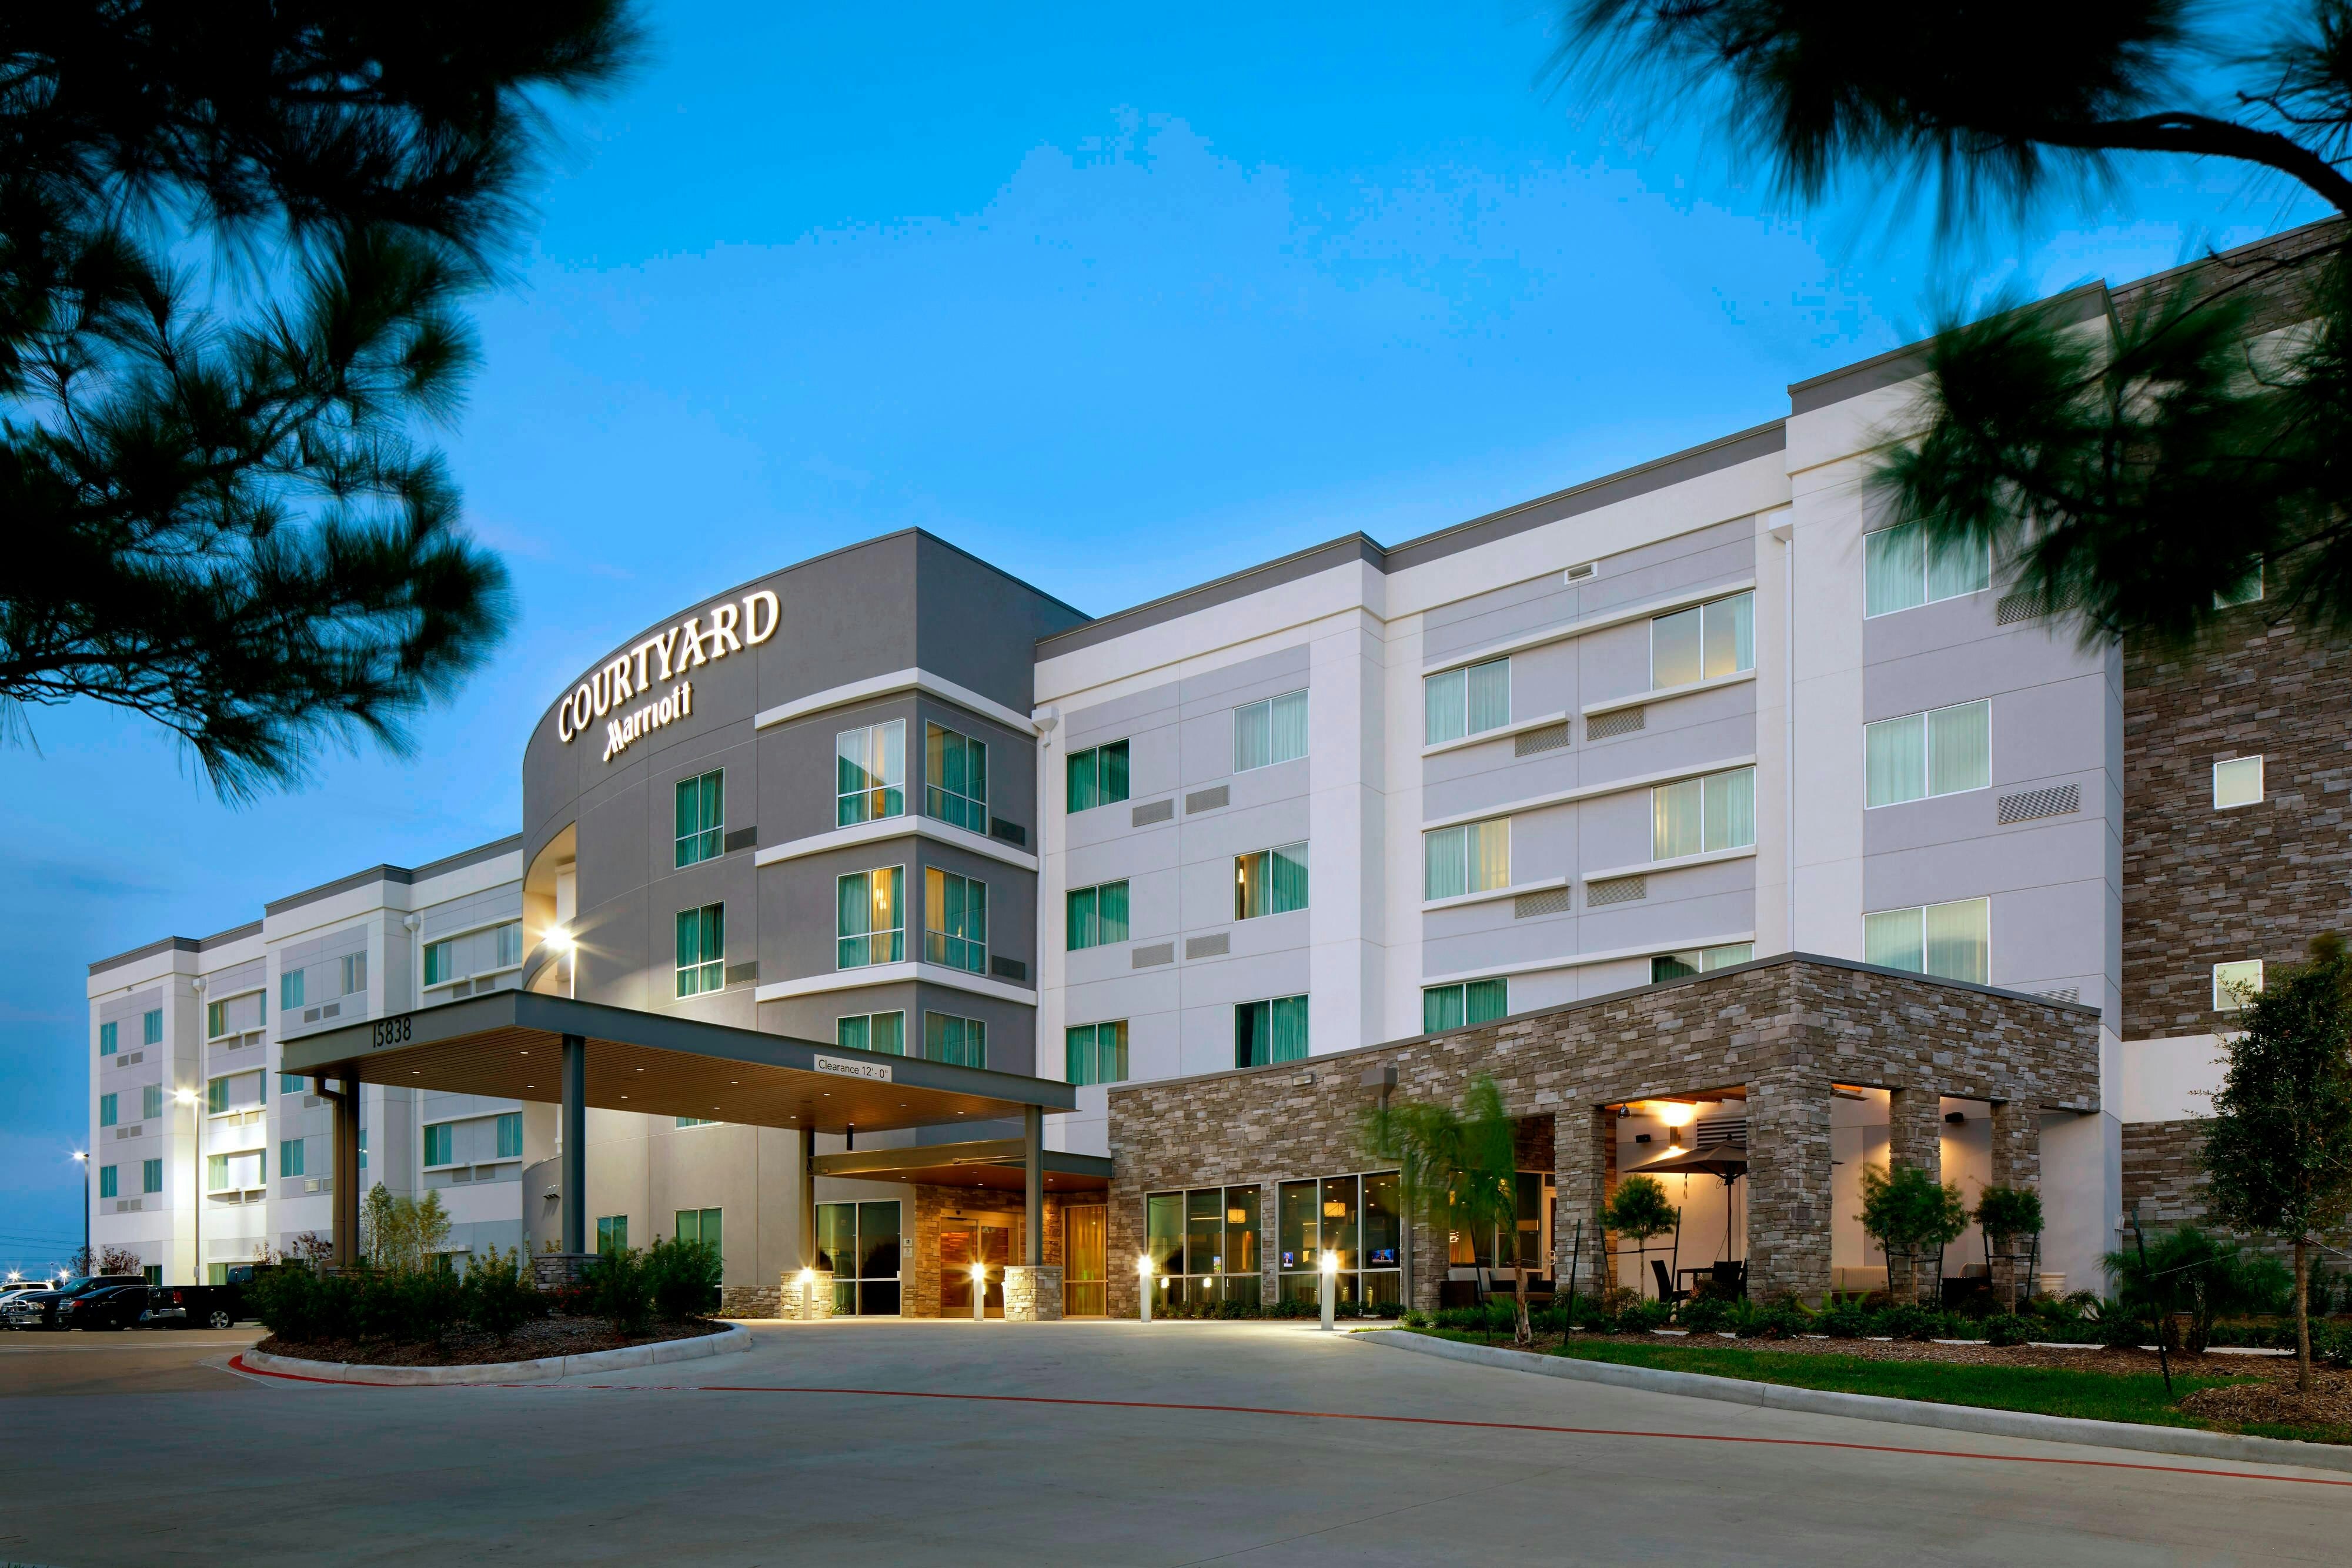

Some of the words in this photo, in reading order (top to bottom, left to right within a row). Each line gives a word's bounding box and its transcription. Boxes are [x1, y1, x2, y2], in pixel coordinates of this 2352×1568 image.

[558, 590, 781, 743] COURTYARD
[603, 681, 694, 763] Marriott
[373, 1017, 412, 1048] 15838
[818, 1059, 859, 1074] Clearance
[861, 1066, 874, 1076] 12'
